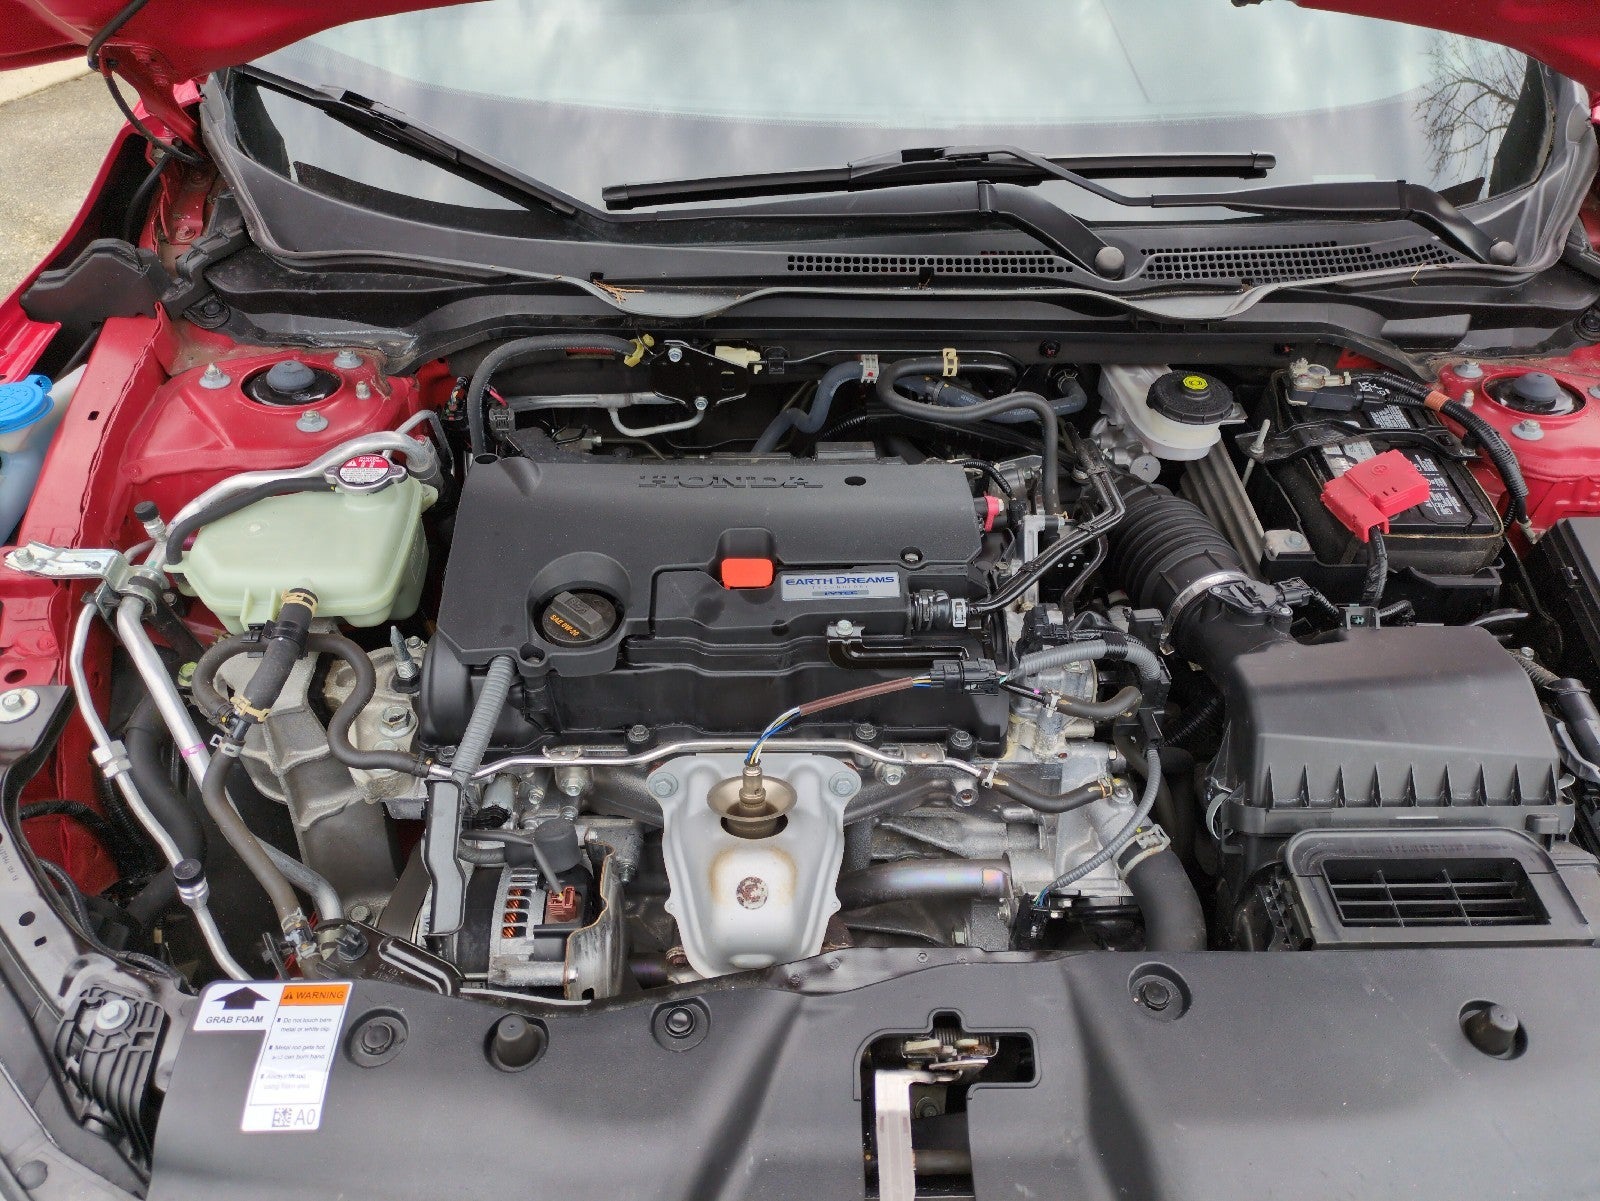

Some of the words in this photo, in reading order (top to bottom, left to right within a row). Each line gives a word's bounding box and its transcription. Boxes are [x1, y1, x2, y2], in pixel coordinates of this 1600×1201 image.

[638, 475, 823, 488] HONDA
[836, 576, 895, 584] DREAMS
[550, 614, 563, 626] SAE
[296, 991, 344, 1000] WARNING
[205, 1016, 233, 1024] GRAB
[235, 1015, 264, 1023] FOAM
